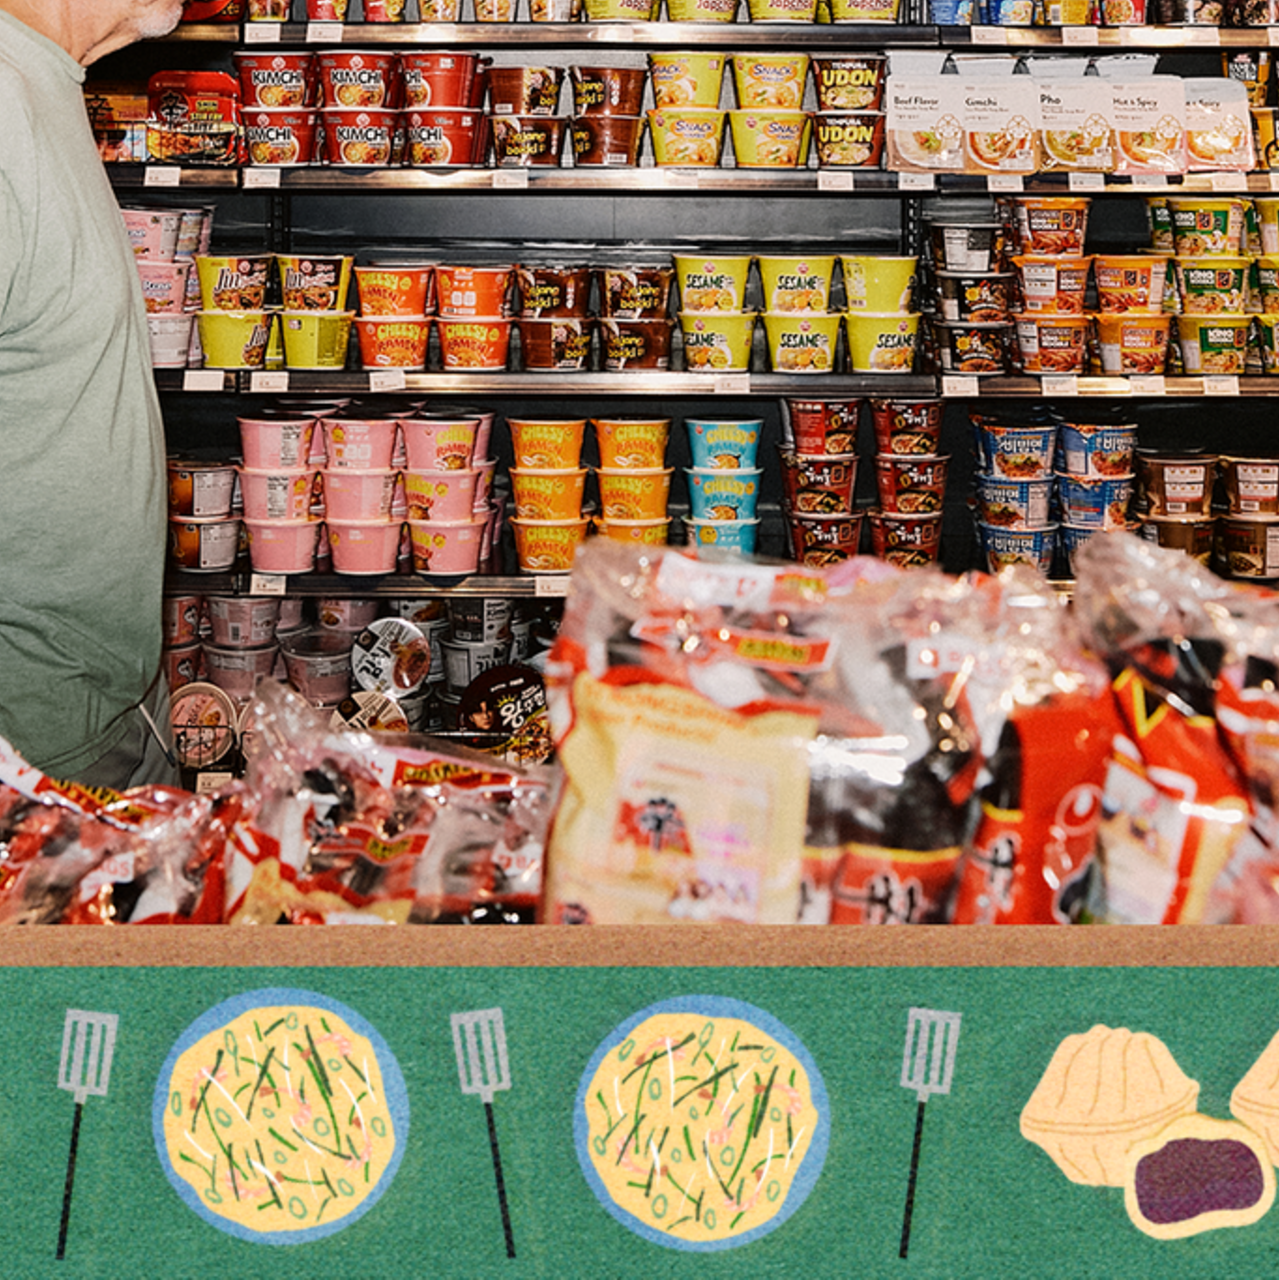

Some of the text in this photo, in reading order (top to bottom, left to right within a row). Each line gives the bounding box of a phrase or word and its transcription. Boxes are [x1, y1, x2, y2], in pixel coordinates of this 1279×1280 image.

[252, 70, 303, 84] KIMCHI
[330, 70, 382, 84] KIMCHI
[822, 70, 877, 87] UDON
[336, 126, 388, 141] KIMCHI
[819, 125, 874, 142] UDON
[686, 274, 725, 290] SESAME
[778, 275, 817, 290] SESAME
[781, 333, 820, 348] SESAME
